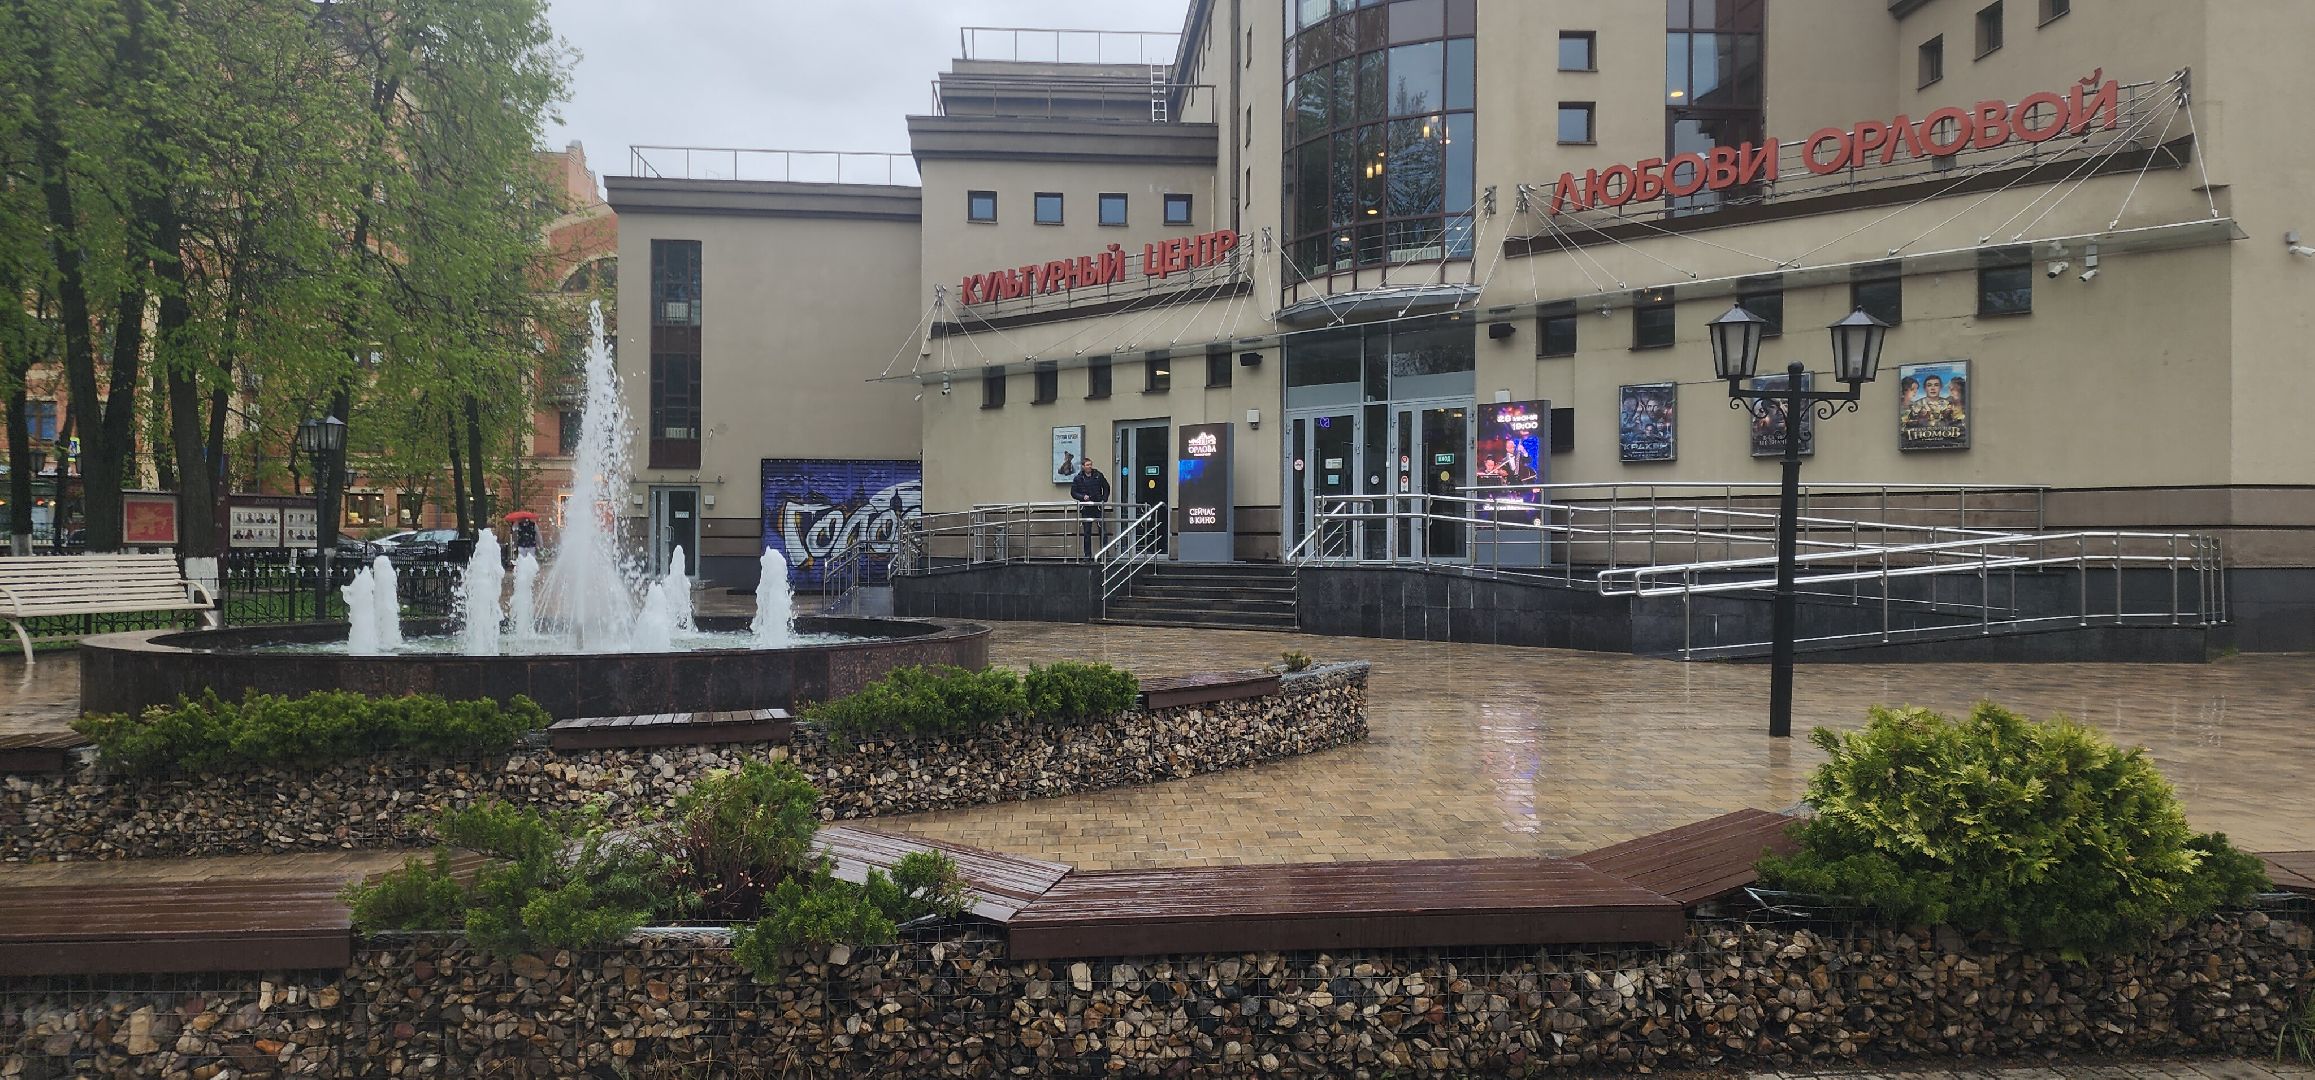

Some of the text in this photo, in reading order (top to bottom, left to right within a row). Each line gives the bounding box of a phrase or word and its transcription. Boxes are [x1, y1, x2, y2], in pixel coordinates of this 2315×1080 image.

[1549, 67, 2119, 214] ЛЮБОВИ ОРЛОВОЙ
[962, 229, 1238, 304] КУЛЬТУРНЫЙ ЦЕНТР
[1188, 445, 1217, 454] ОРЛОВА
[1189, 508, 1216, 516] СЕЙЧАС
